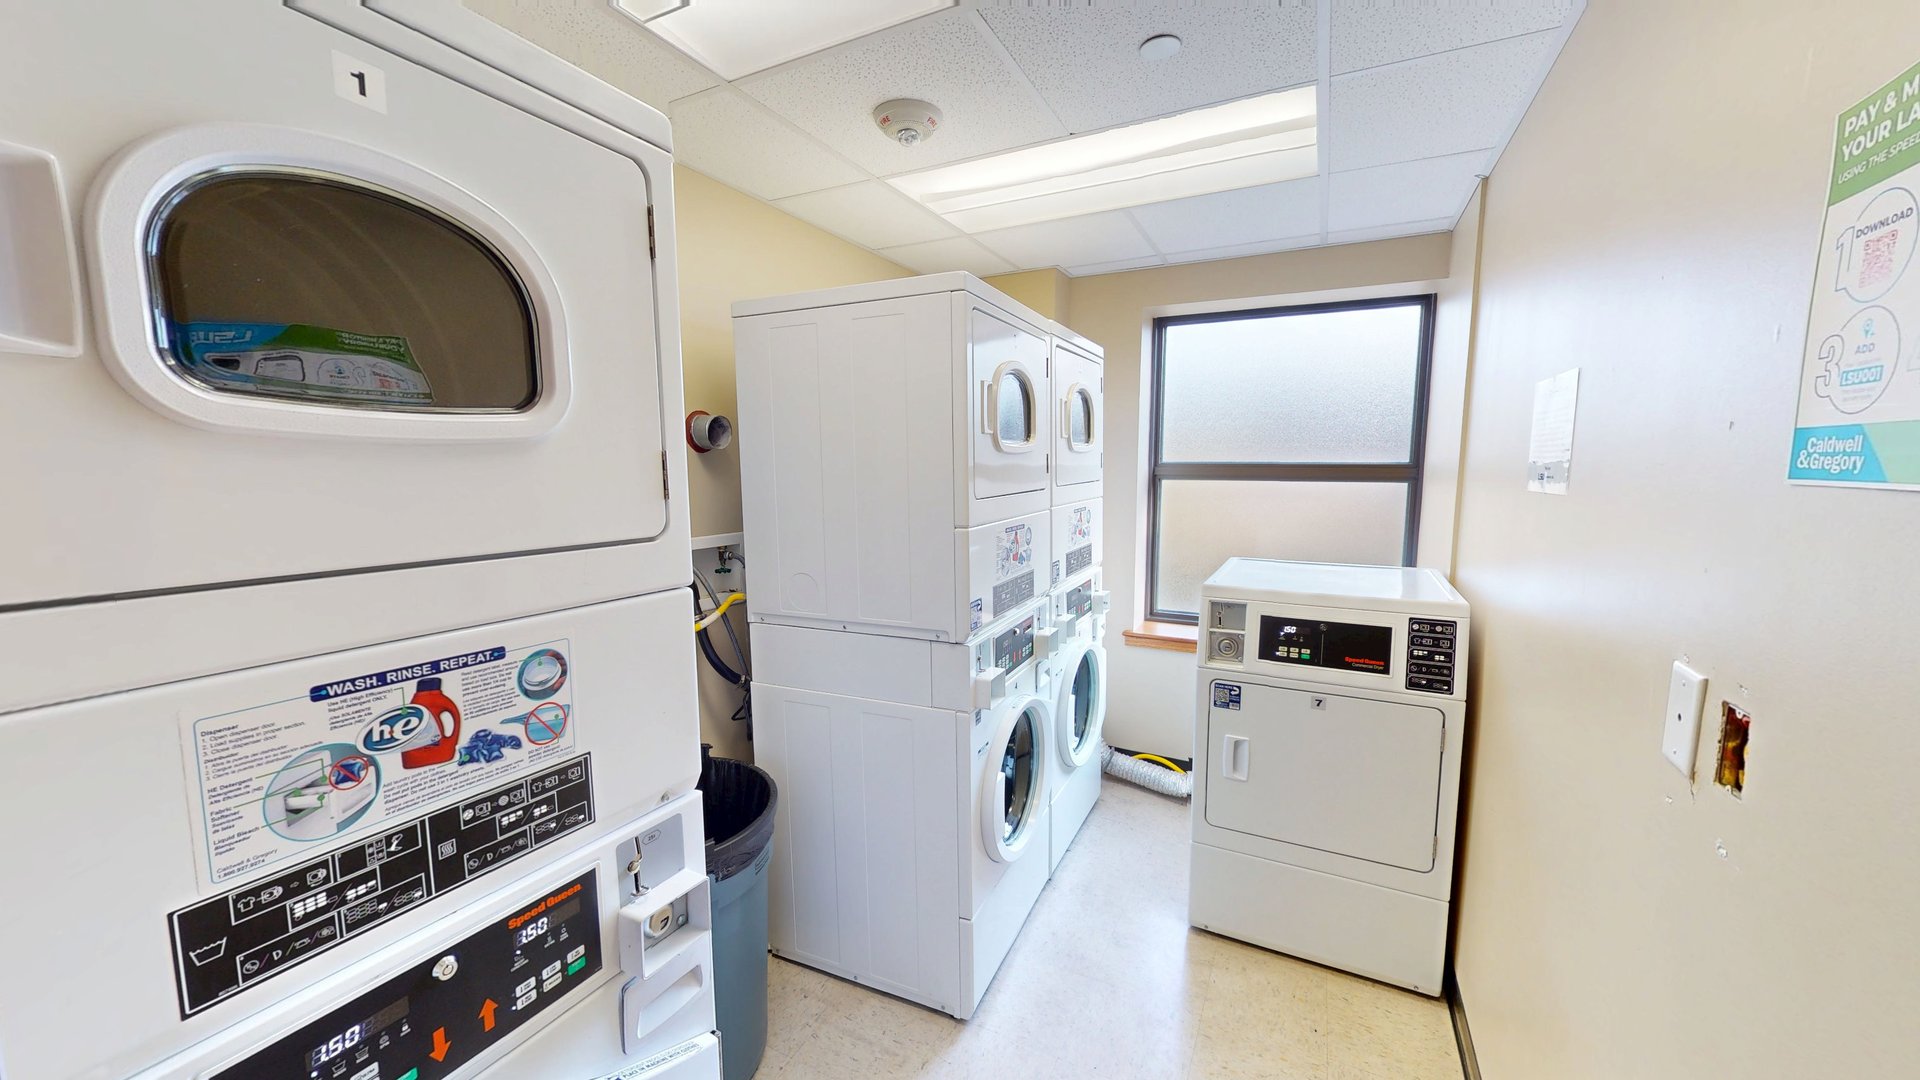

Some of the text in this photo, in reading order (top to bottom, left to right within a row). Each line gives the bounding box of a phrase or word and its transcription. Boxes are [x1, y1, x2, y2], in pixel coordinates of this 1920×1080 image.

[350, 71, 367, 97] 1
[1844, 100, 1880, 138] PAY
[1884, 91, 1898, 113] &
[1842, 120, 1892, 162] YOUR
[1837, 161, 1867, 184] USING
[1868, 149, 1888, 169] THE
[1855, 206, 1914, 239] DOWNLOAD
[1855, 342, 1876, 355] ADD
[1807, 434, 1863, 453] Caldwell
[1797, 450, 1865, 474] &Gregory
[326, 651, 494, 697] WASH. RINSE. REPEAT.
[345, 700, 372, 709] detergent
[1314, 698, 1323, 707] 7
[201, 724, 239, 738] Dispenser
[210, 734, 228, 742] Open
[229, 727, 260, 738] dispenser
[210, 741, 227, 749] Load
[229, 734, 255, 744] supplies
[263, 728, 283, 736] proper
[371, 717, 420, 742] he
[211, 747, 230, 755] Close
[231, 739, 262, 750] dispenser
[220, 778, 253, 791] Detergent
[393, 777, 410, 785] laundry
[438, 771, 459, 781] detergent
[210, 807, 232, 817] Fabric
[211, 811, 240, 823] Softener
[214, 827, 260, 846] Liquid Bleach
[217, 860, 245, 874] Caldwell
[252, 849, 278, 861] Gregory
[507, 883, 583, 929] Speed Queen
